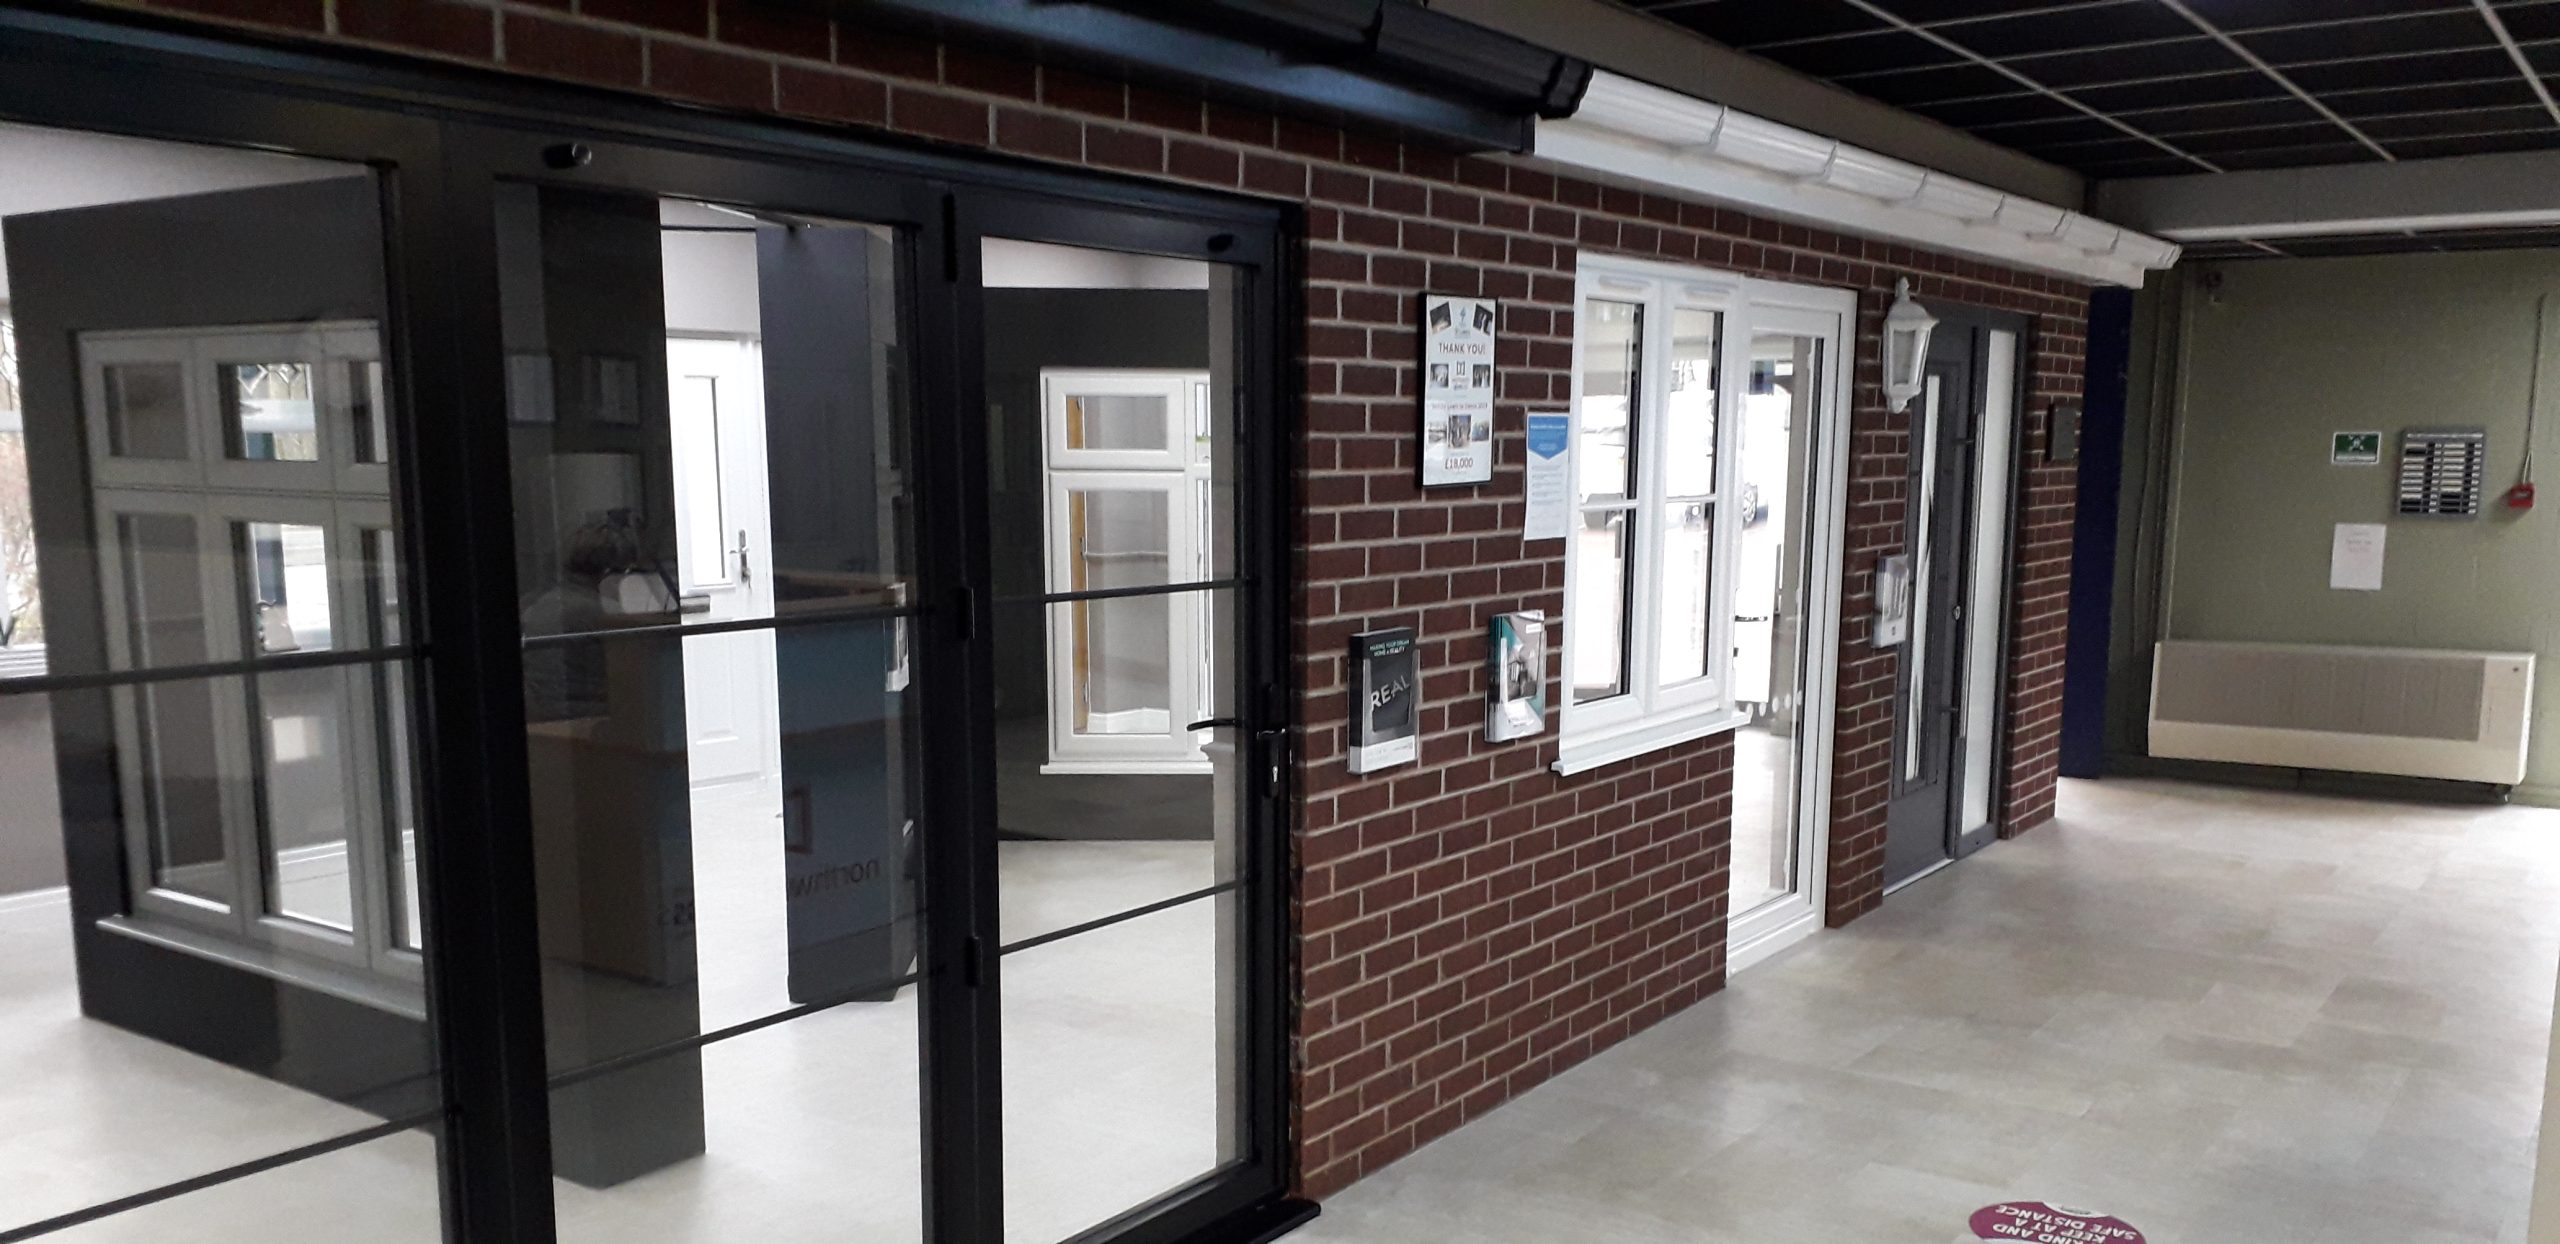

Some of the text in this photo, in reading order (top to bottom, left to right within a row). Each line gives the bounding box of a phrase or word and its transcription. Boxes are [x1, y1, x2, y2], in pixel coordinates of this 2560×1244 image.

[1439, 343, 1486, 355] THANK YOU!
[1370, 675, 1410, 711] REAL
[1995, 1204, 2086, 1229] DISTANCE
[1992, 1222, 2034, 1240] AND
[2013, 1216, 2107, 1244] KEEP AT A
[2089, 1222, 2139, 1241] SAFE
